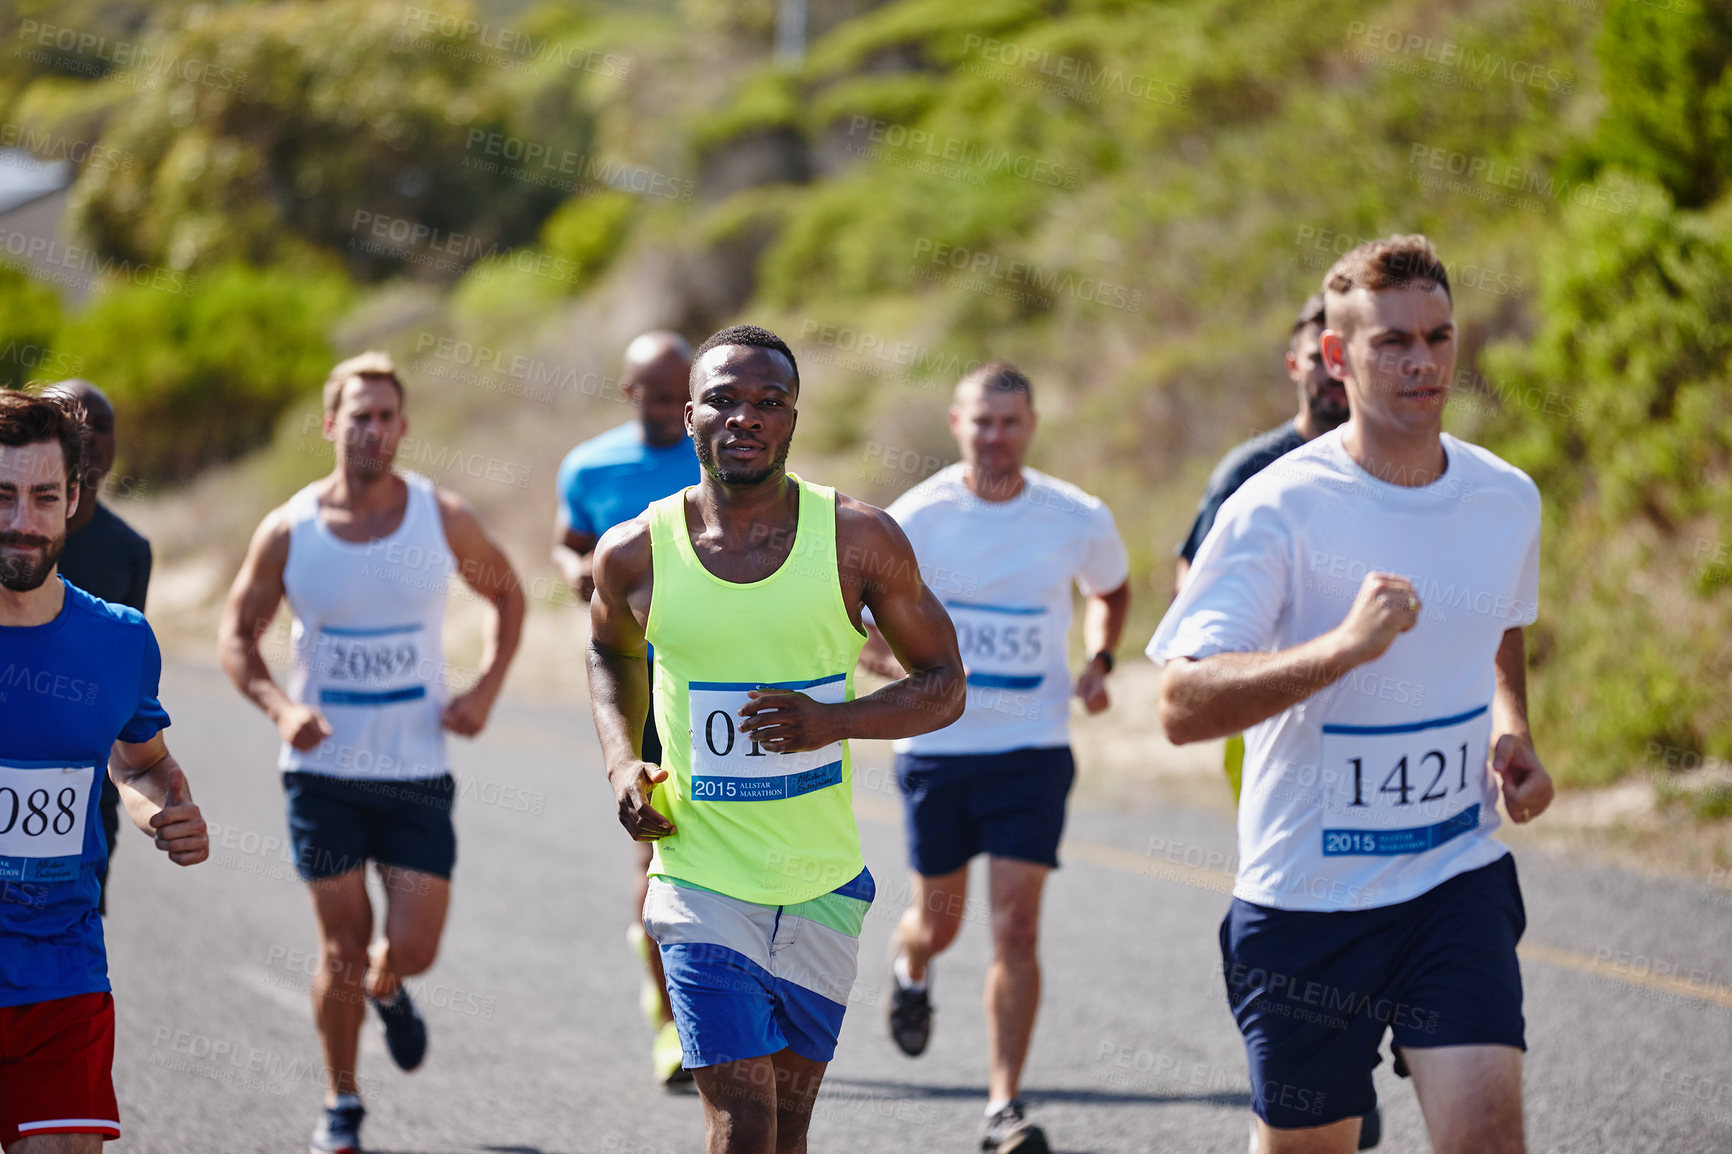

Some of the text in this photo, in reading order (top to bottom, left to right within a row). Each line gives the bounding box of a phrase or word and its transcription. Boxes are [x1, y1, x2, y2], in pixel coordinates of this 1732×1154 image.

[1346, 741, 1469, 808] 1421
[695, 781, 736, 797] 2015
[739, 789, 783, 798] MARATHON
[0, 787, 76, 836] 088
[1327, 833, 1376, 852] 2015
